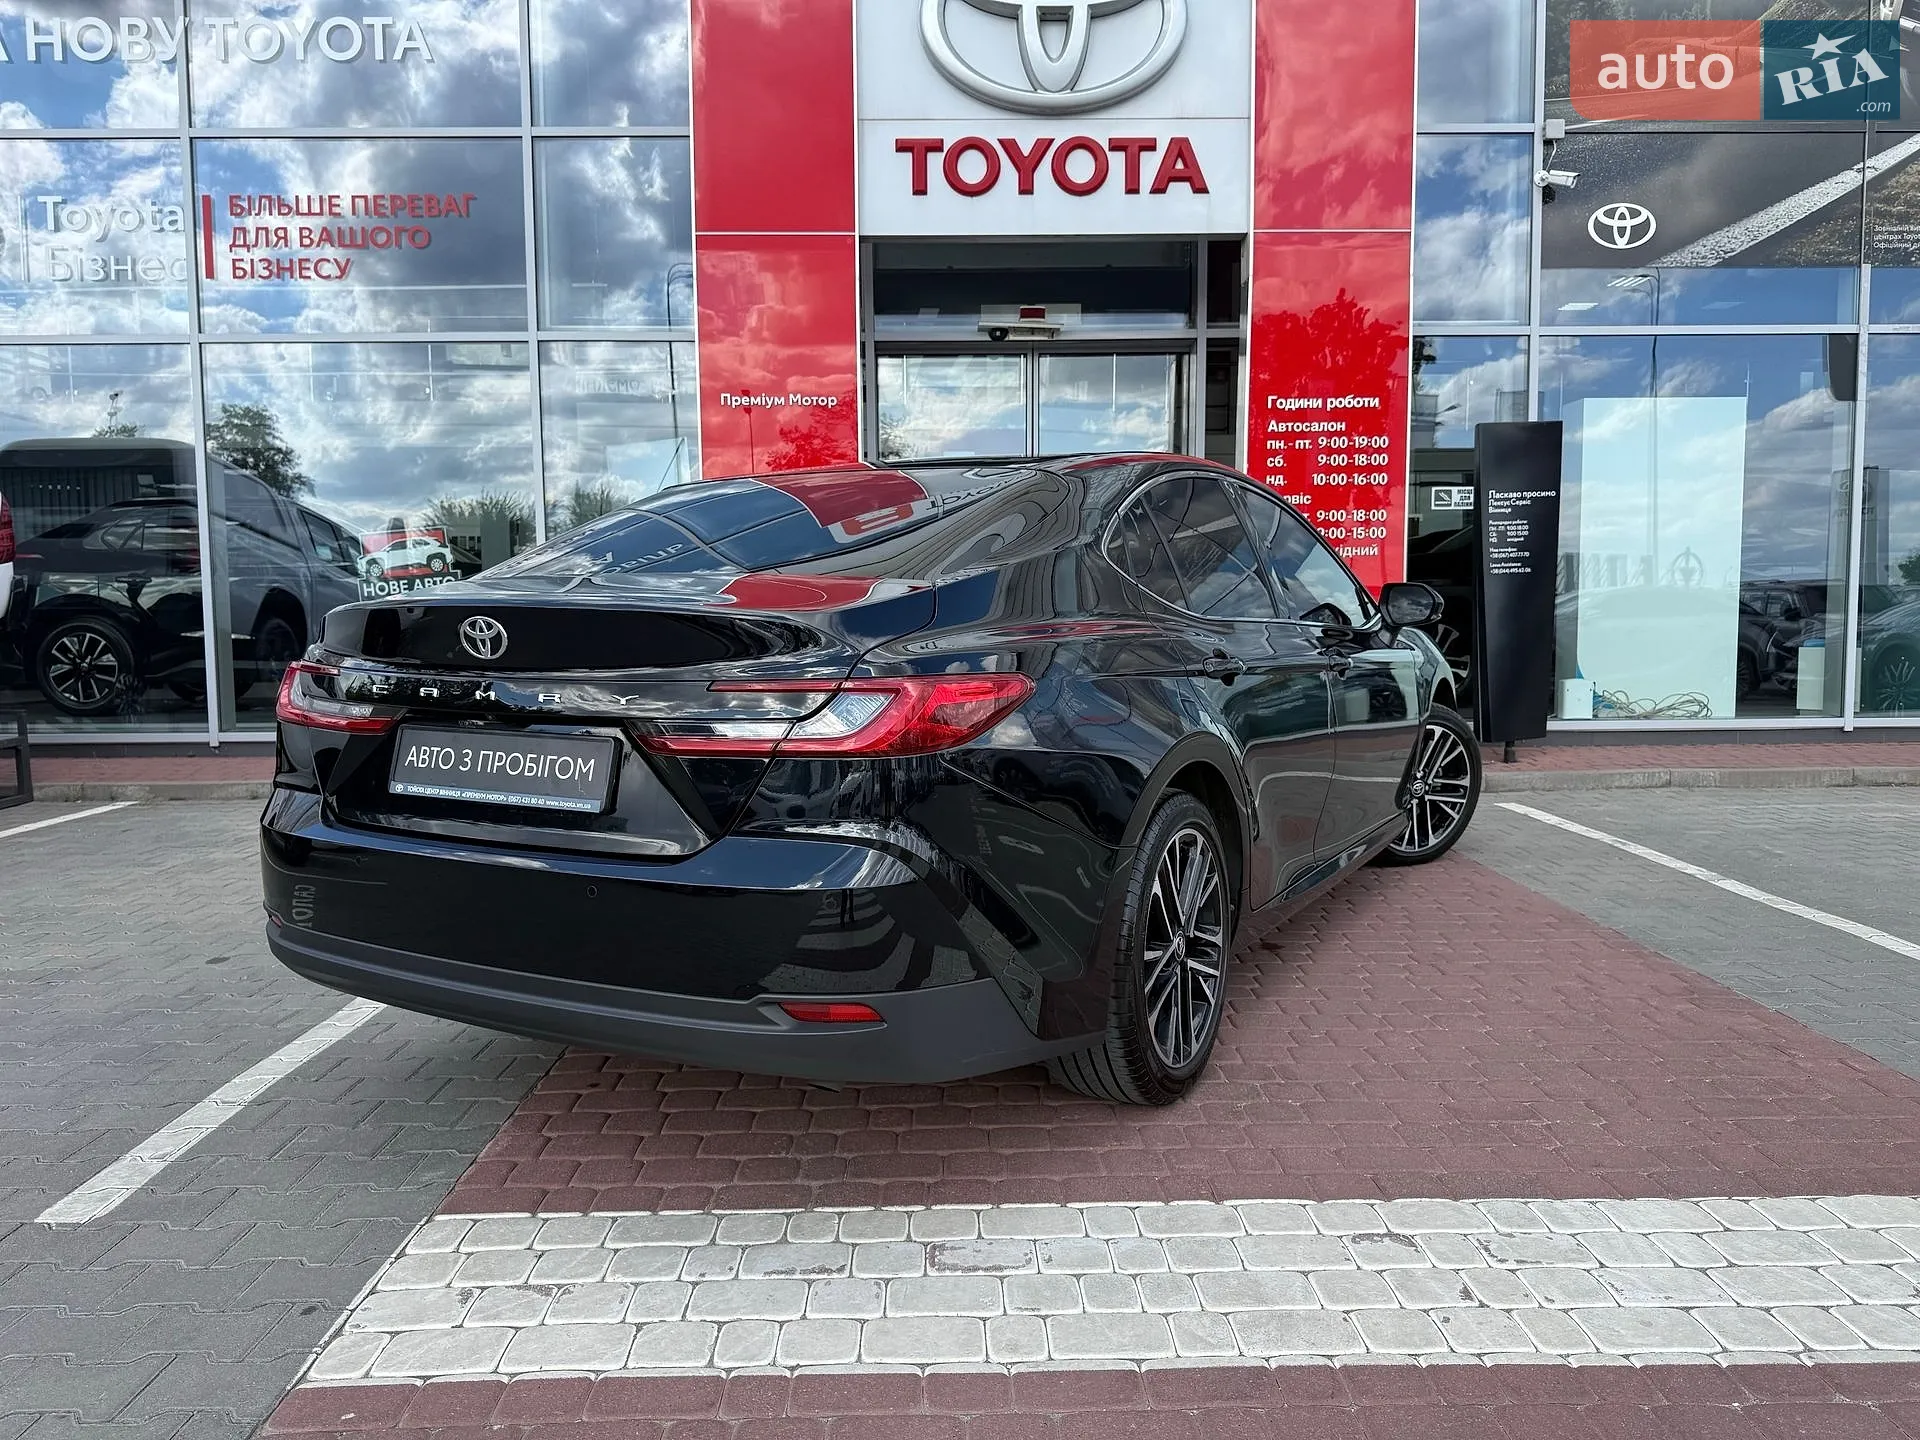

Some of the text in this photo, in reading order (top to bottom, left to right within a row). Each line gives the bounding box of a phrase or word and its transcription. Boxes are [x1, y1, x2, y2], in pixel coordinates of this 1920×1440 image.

[25, 16, 189, 62] НОВУ
[204, 16, 433, 62] TOYOTA
[895, 136, 1210, 197] TOYOTA
[229, 194, 477, 218] БІЛЬШЕ ПЕРЕВАГ
[37, 195, 185, 242] Toyota
[229, 225, 431, 253] ДЛЯ ВАШОГО
[49, 246, 187, 282] Бізнес
[231, 257, 352, 280] БІЗНЕСУ
[720, 393, 837, 408] Преміум Мотор
[1267, 395, 1380, 411] Години роботи
[1267, 420, 1346, 433] Автосалон
[1266, 454, 1287, 468] сб.
[1265, 474, 1288, 487] нд.
[363, 579, 409, 597] НОВЕ
[372, 684, 639, 706] CAMRY
[404, 745, 595, 782] АВТО З ПРОБІГОМ
